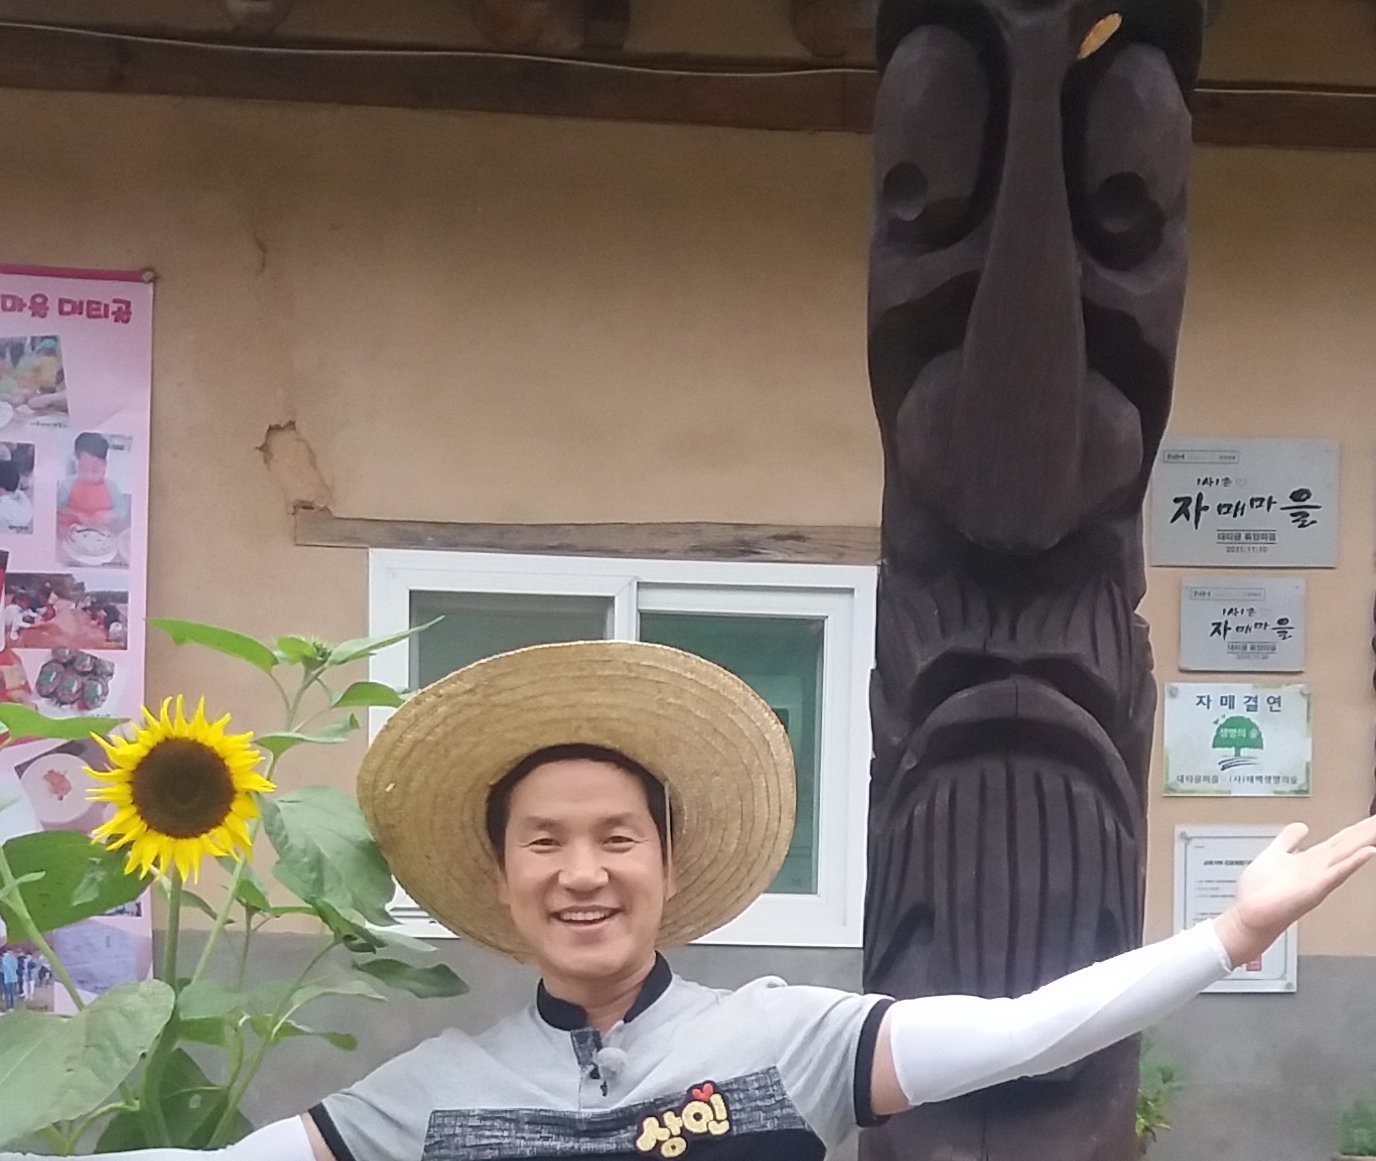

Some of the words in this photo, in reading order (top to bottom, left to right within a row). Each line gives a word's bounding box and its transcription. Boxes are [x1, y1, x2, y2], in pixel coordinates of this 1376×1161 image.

[57, 295, 133, 324] 대티골
[1169, 487, 1323, 531] 자매마을
[1209, 616, 1295, 641] 자매마을
[636, 1093, 730, 1158] 상인
